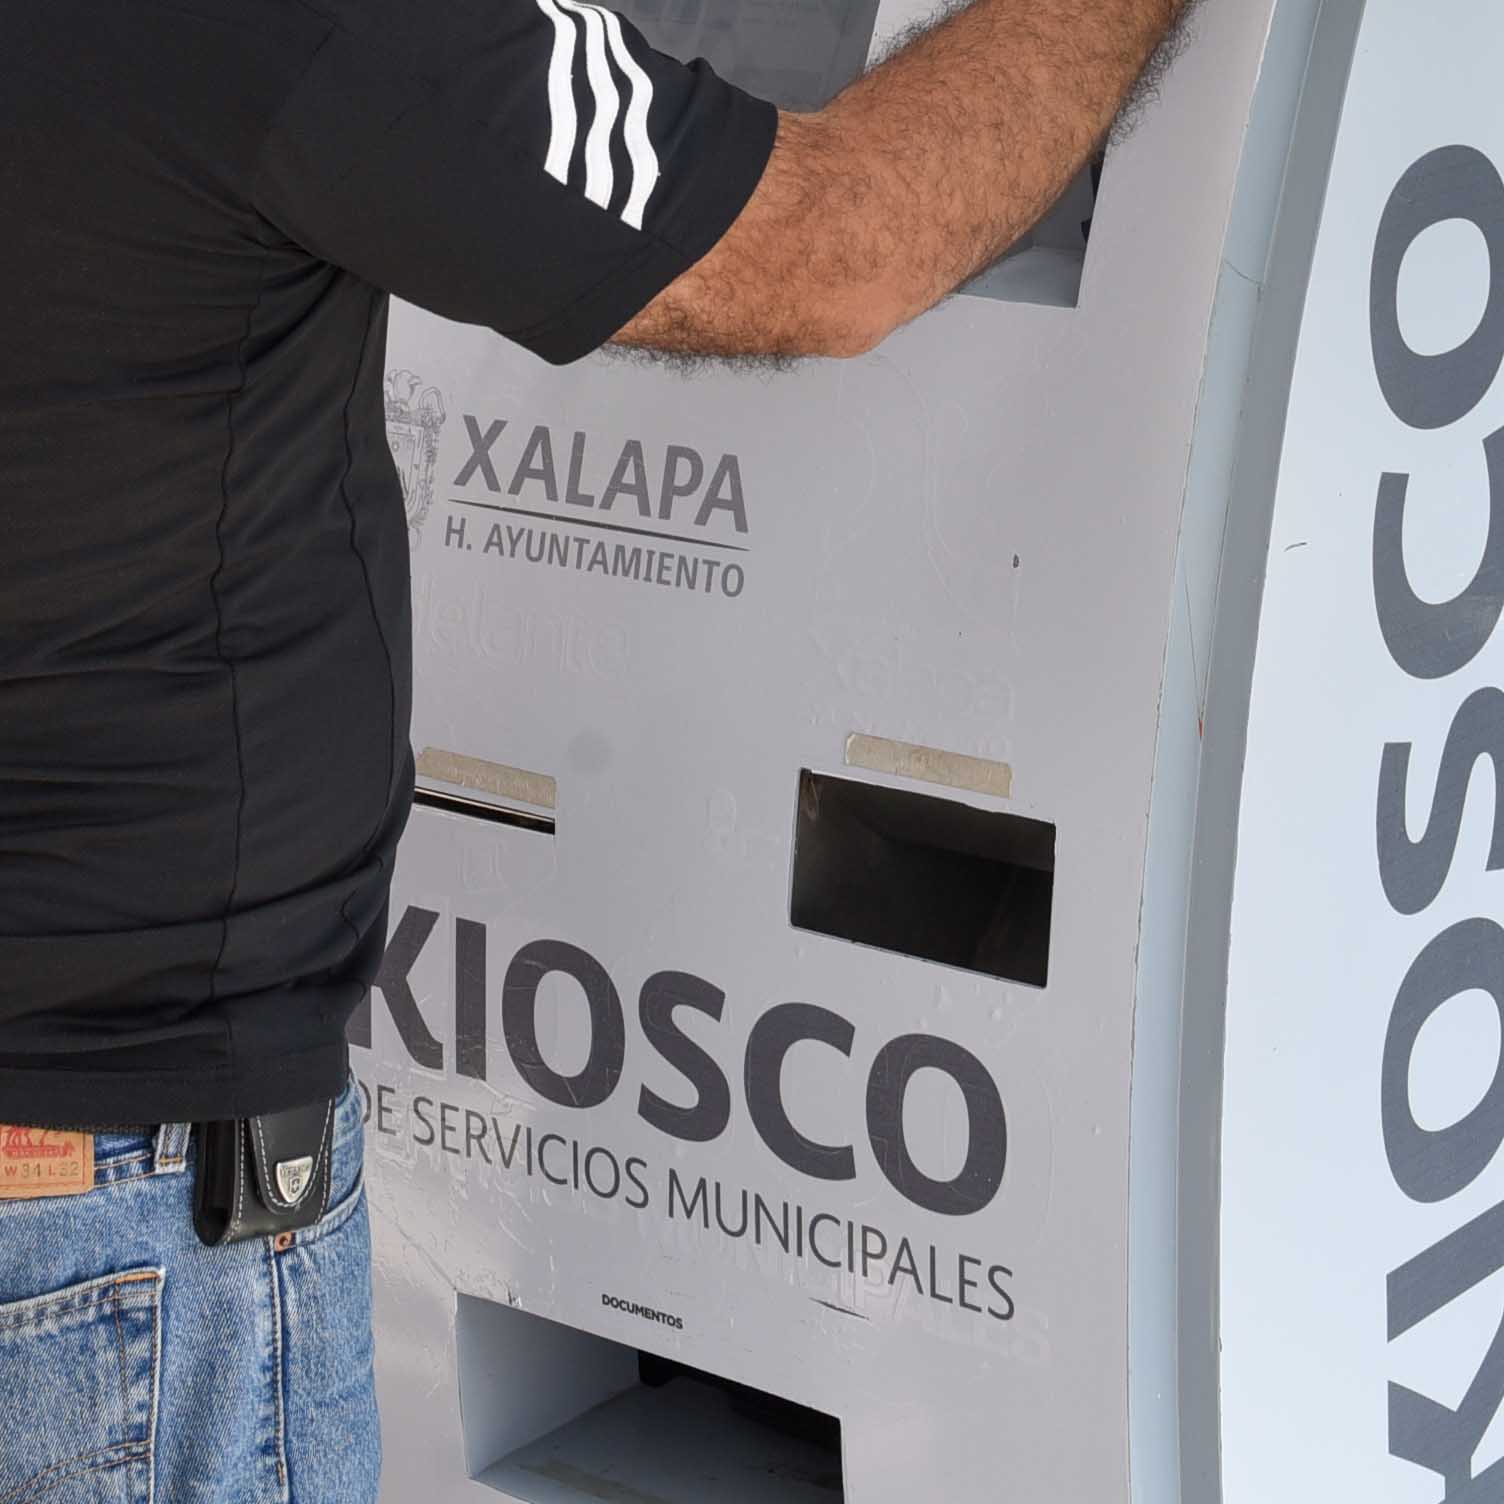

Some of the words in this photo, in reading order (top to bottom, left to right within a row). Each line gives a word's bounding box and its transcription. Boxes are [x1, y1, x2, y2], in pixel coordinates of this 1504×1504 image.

[453, 414, 749, 532] XALAPA
[445, 516, 472, 550] H.
[483, 523, 745, 597] AYUNTAMIENTO
[348, 904, 1008, 1216] KIOSCO
[360, 1085, 395, 1135] DE
[413, 1096, 649, 1208] SERVICIOS
[668, 1168, 1015, 1320] MUNICIPALES
[601, 1293, 684, 1330] DOCUMENTOS
